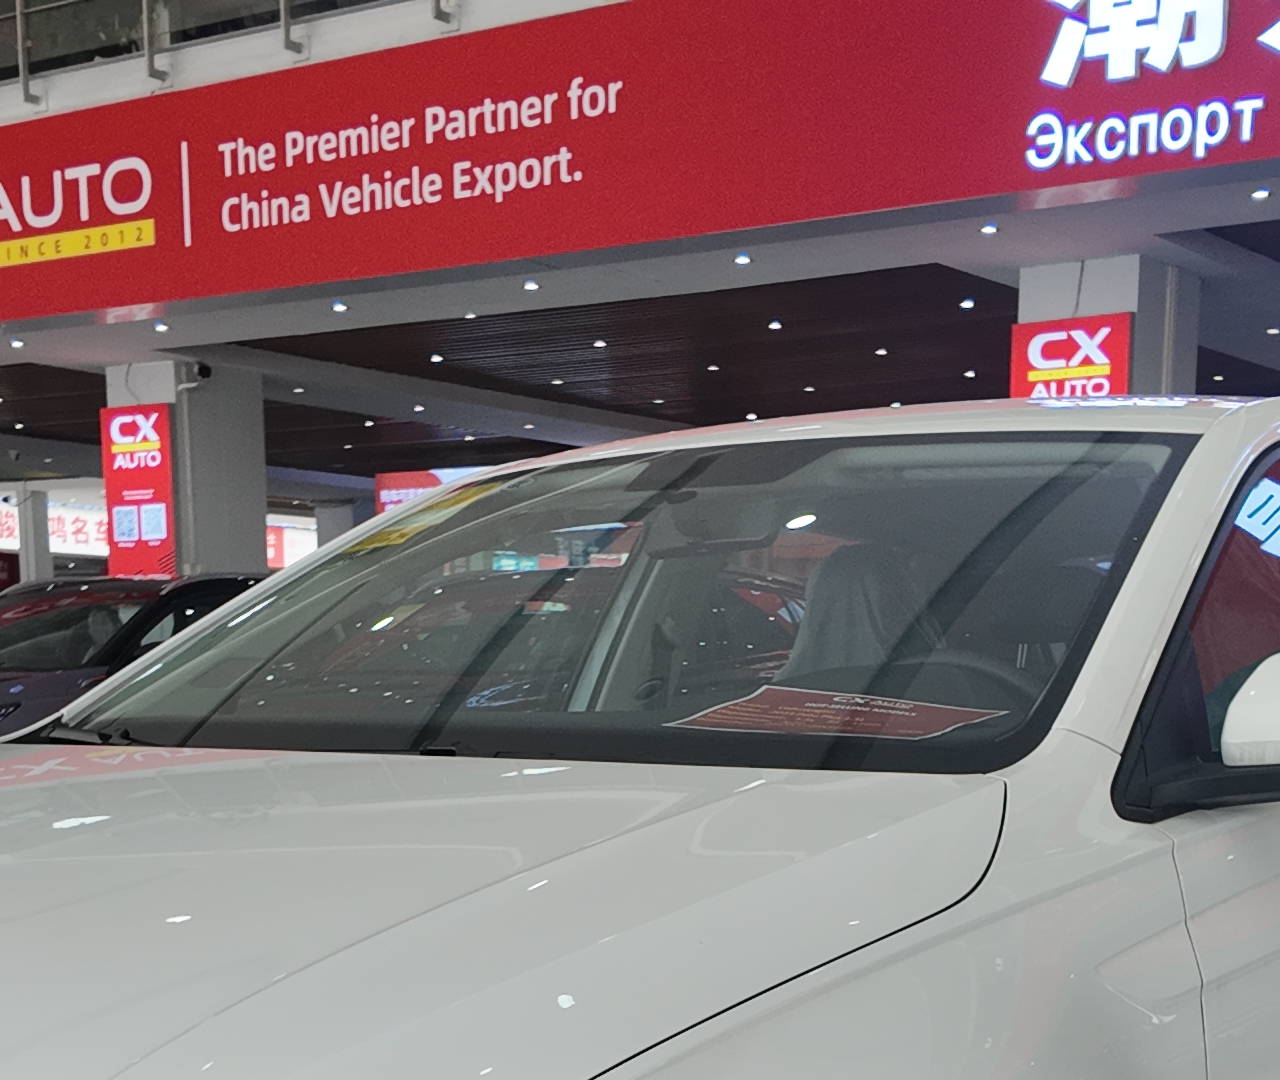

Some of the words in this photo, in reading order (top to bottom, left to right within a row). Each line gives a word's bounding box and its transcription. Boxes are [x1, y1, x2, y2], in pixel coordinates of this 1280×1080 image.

[218, 136, 277, 177] The
[284, 113, 416, 168] Premier
[425, 91, 559, 145] Partner
[567, 76, 623, 121] for
[1025, 93, 1265, 170] Экспорт
[221, 189, 312, 234] China
[319, 165, 443, 219] Vehicle
[453, 145, 584, 204] Export.
[83, 226, 145, 251] 2012
[1027, 326, 1112, 369] CX
[1030, 377, 1111, 399] AUTO
[109, 412, 161, 444] CX
[113, 450, 162, 470] AUTO
